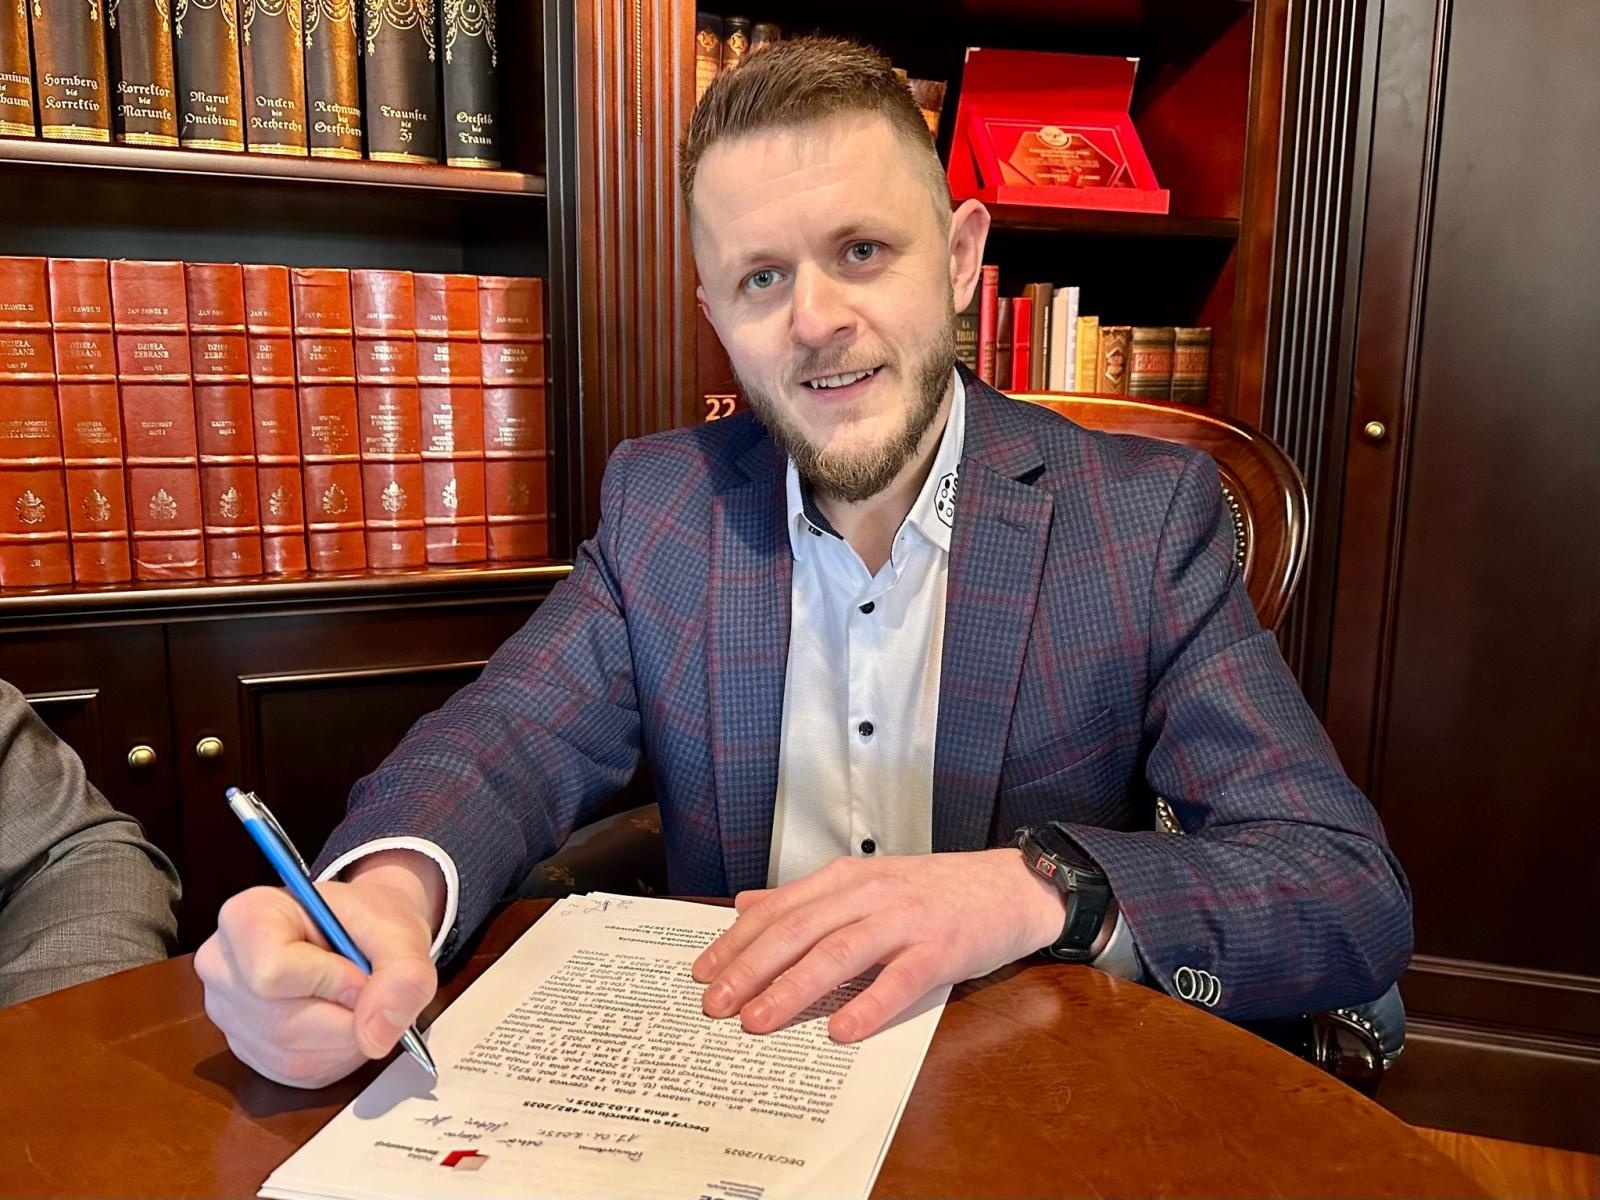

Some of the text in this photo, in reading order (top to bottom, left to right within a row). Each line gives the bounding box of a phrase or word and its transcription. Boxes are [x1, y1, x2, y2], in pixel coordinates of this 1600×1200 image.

[705, 398, 735, 422] 22
[522, 1100, 580, 1113] 482/2025
[643, 1108, 669, 1117] dnia
[749, 1106, 804, 1119] podstawie
[597, 1111, 649, 1122] wsparciu
[663, 1120, 709, 1132] Decyzja
[723, 1147, 805, 1166] DEC/3/1/2025
